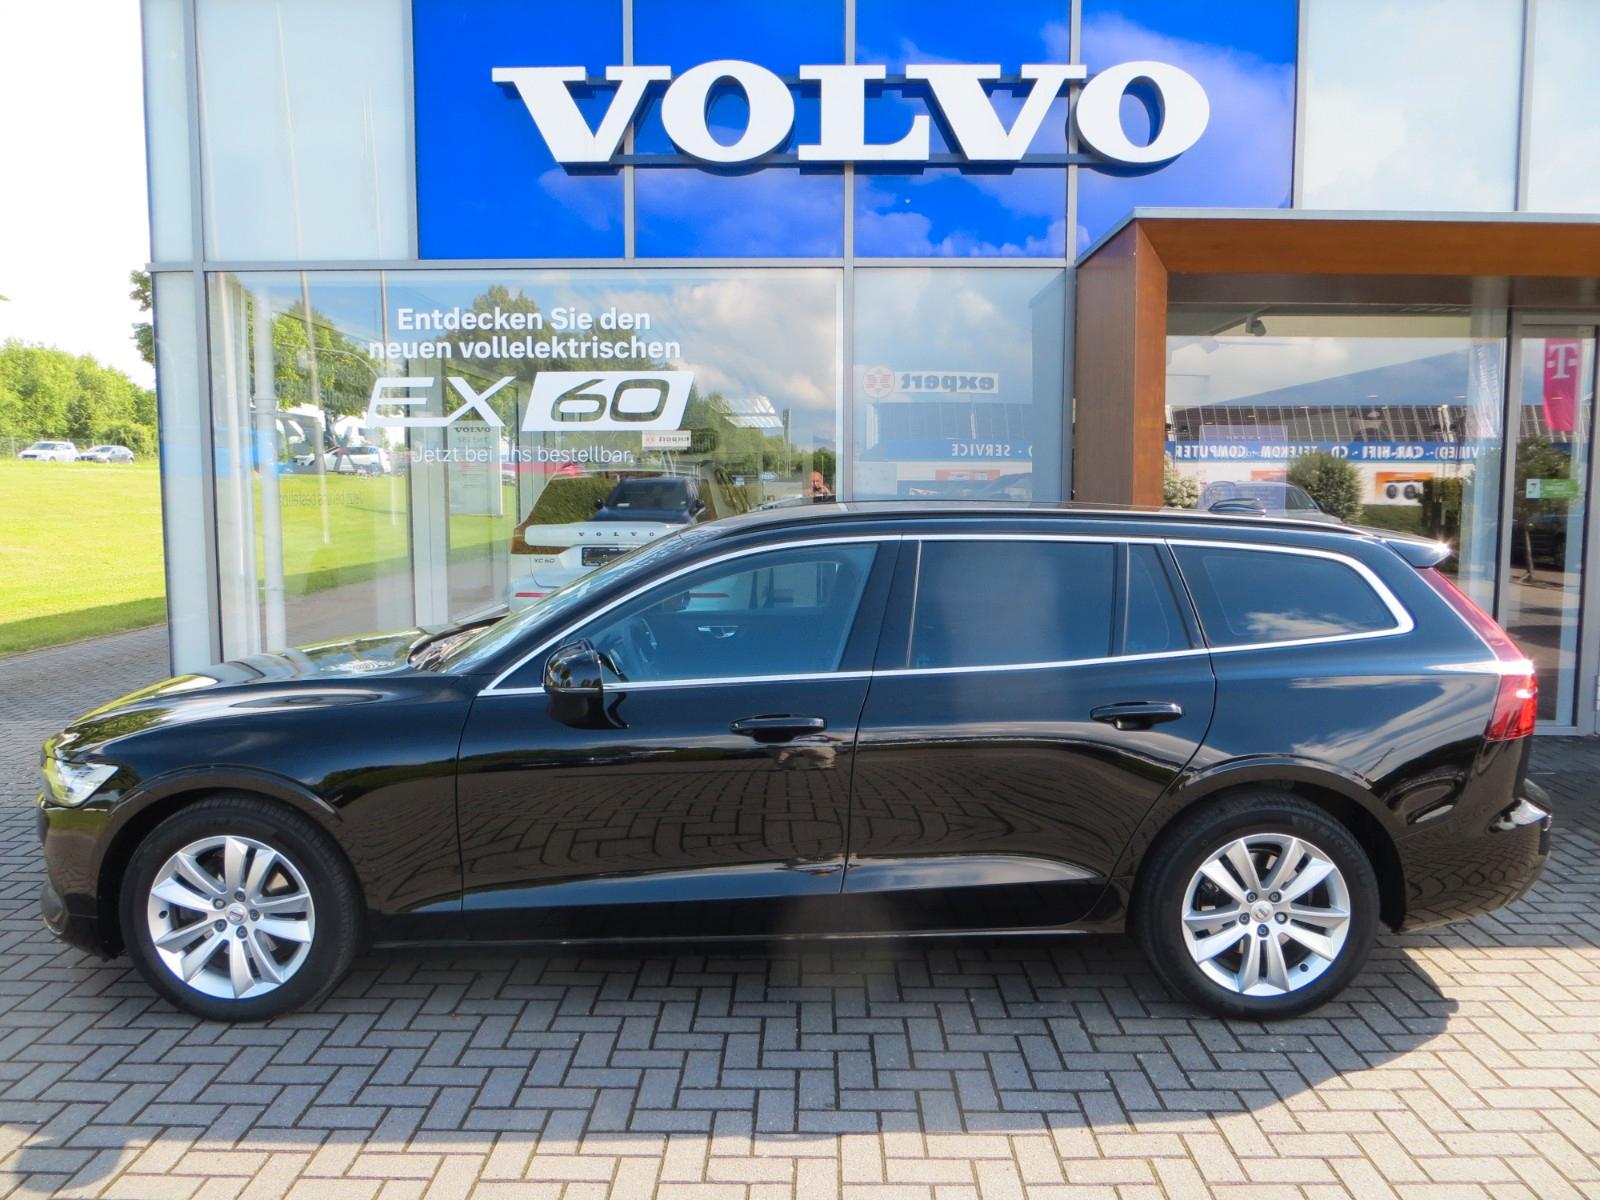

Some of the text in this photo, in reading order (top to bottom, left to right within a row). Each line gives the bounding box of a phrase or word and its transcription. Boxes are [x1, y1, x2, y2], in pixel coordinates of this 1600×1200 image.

[492, 60, 1210, 164] VOLVO
[397, 307, 651, 331] Entdecken Sie den
[369, 335, 681, 360] neuen vollelektrischen
[366, 376, 517, 428] EX
[550, 378, 671, 423] 60
[413, 446, 458, 463] Jetzt
[465, 446, 493, 462] bei
[537, 446, 635, 462] bestellbar.
